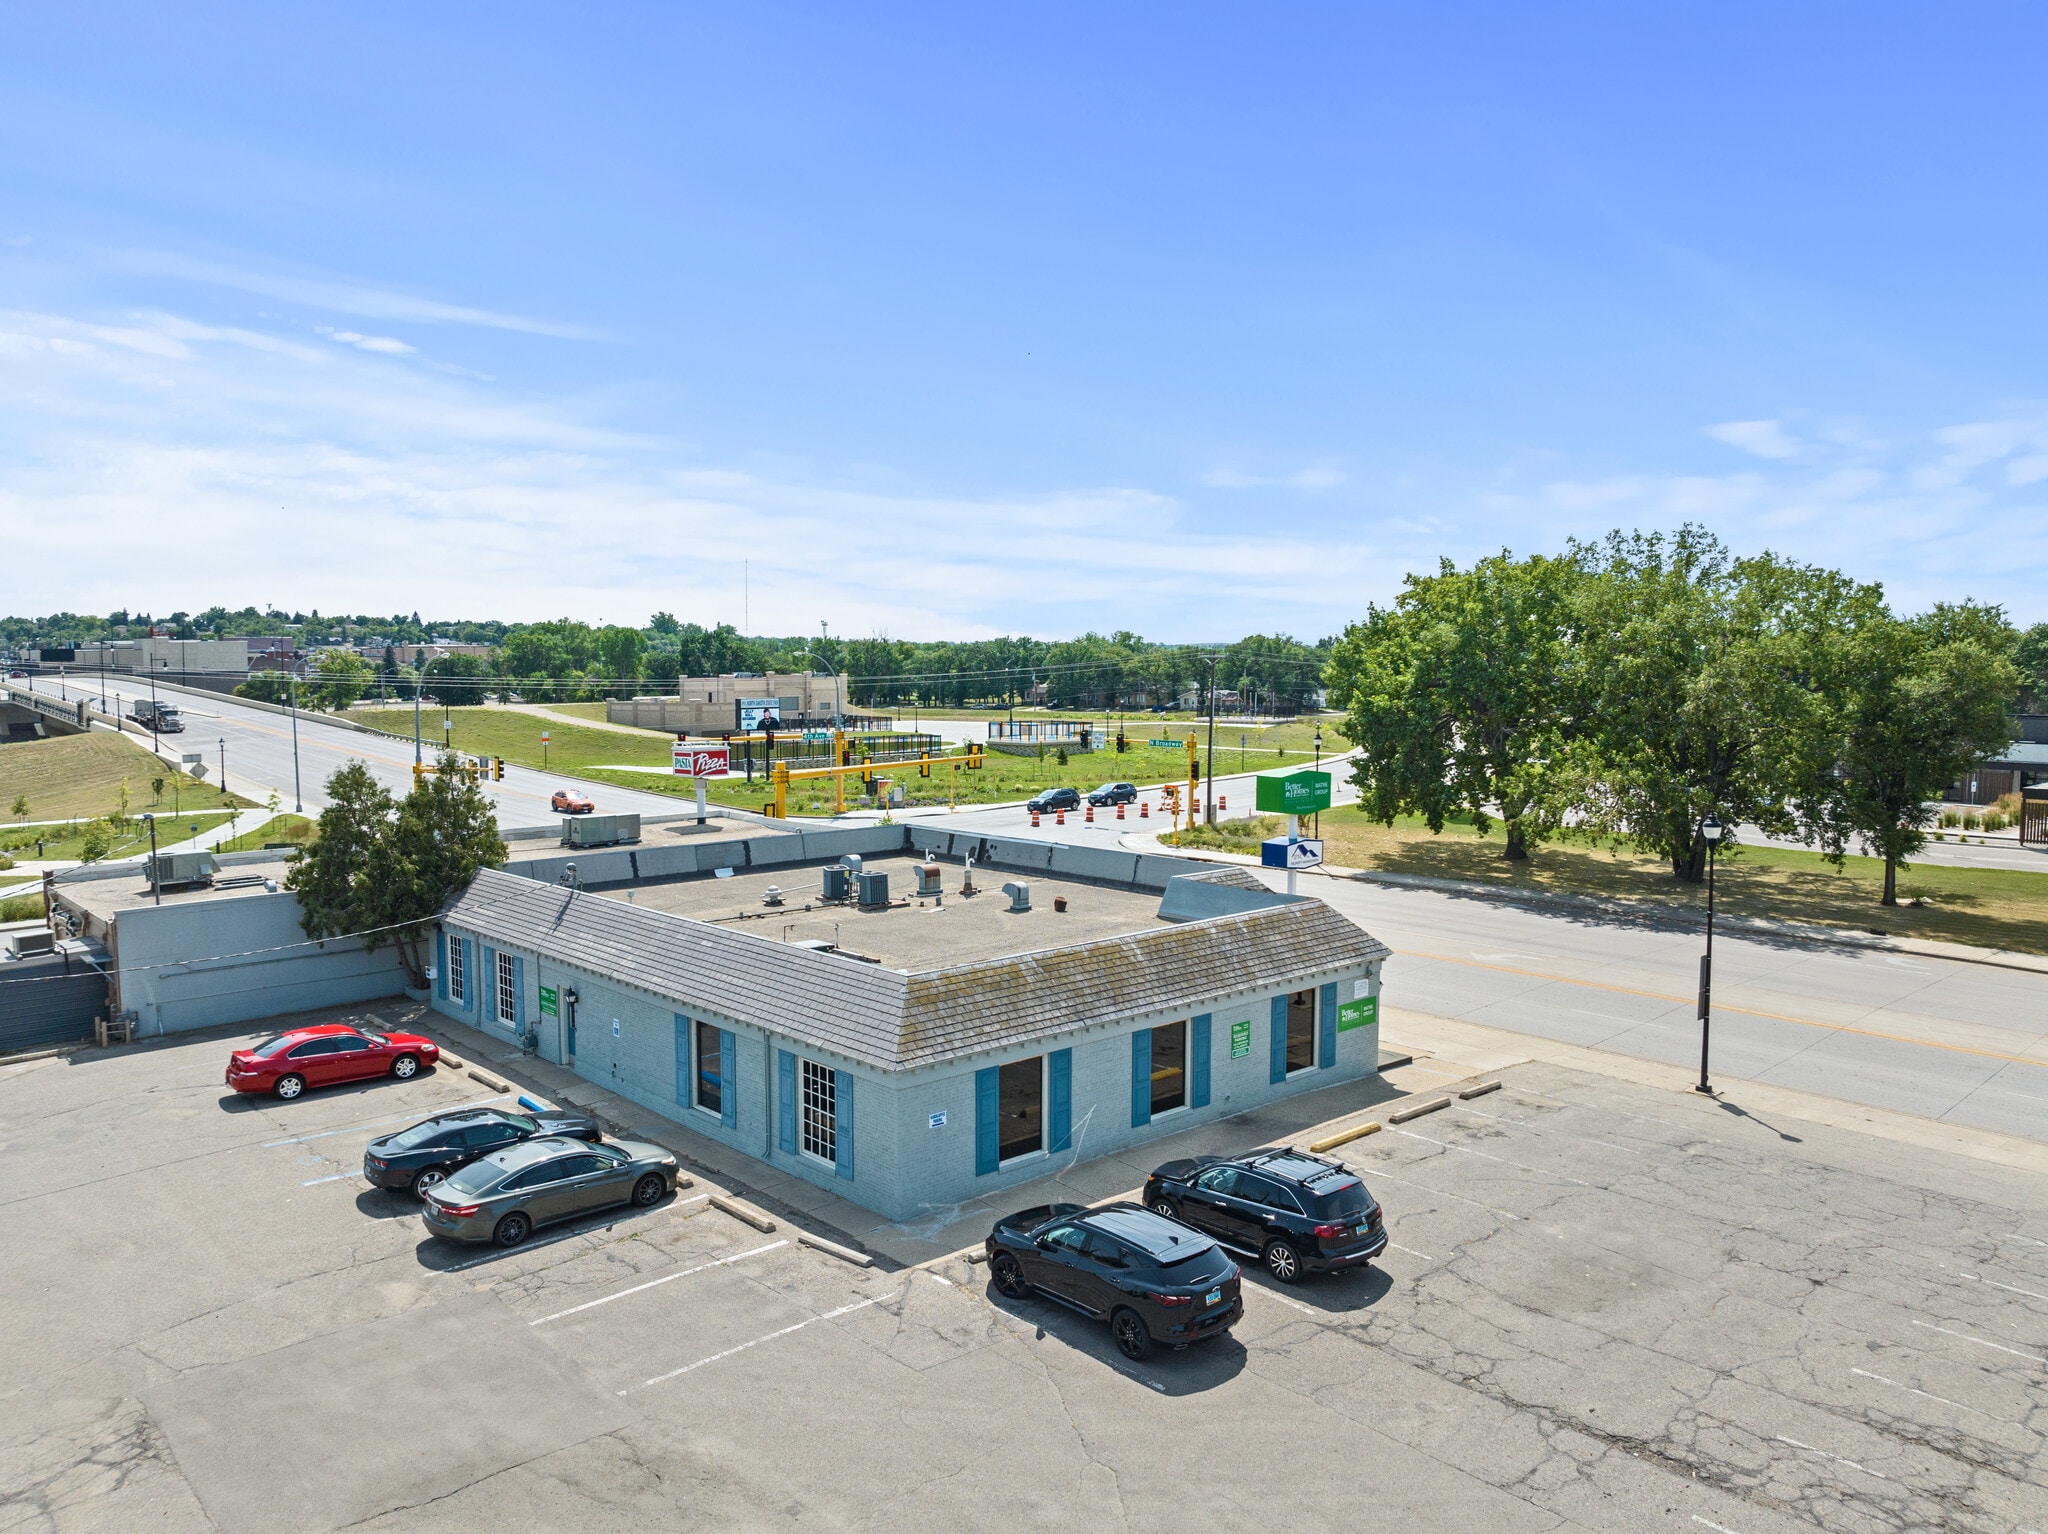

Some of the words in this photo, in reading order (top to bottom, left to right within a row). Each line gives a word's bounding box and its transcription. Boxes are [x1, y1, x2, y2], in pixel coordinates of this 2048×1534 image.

[675, 757, 691, 769] PASTA
[1285, 782, 1302, 790] Better
[1291, 788, 1310, 797] Homes
[1341, 1009, 1354, 1017] Better
[1345, 1012, 1360, 1021] Homes
